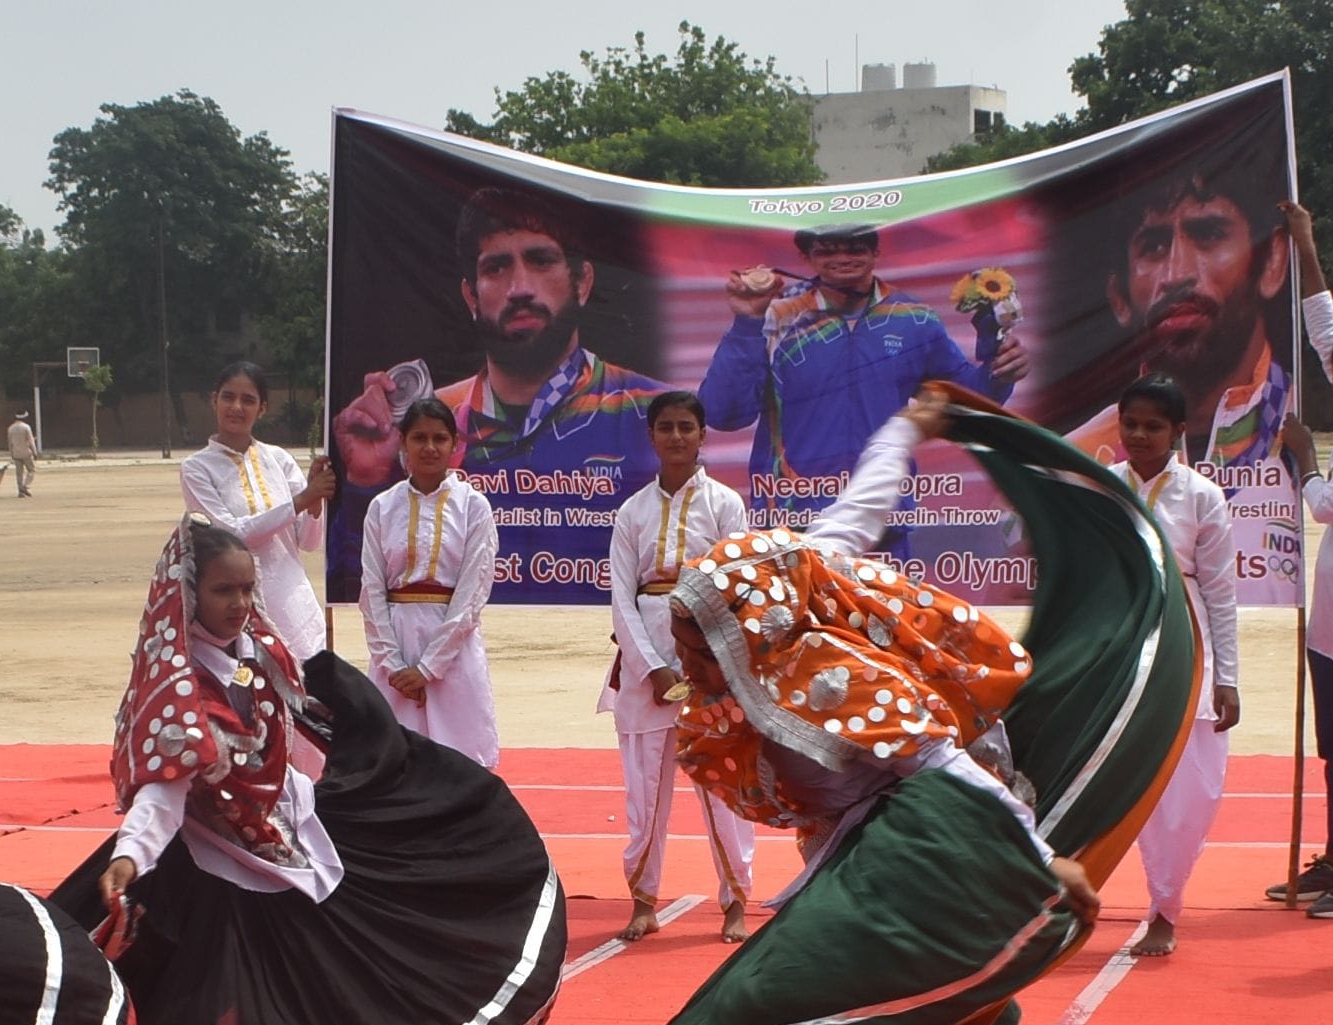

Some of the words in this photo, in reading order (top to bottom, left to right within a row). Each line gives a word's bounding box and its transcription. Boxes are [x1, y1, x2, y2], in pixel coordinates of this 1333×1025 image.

[749, 199, 823, 216] Tokyo
[829, 190, 902, 212] 2020
[515, 469, 615, 500] Dahiya
[544, 508, 562, 526] in
[942, 509, 1002, 526] Throw
[1228, 501, 1296, 520] restlin
